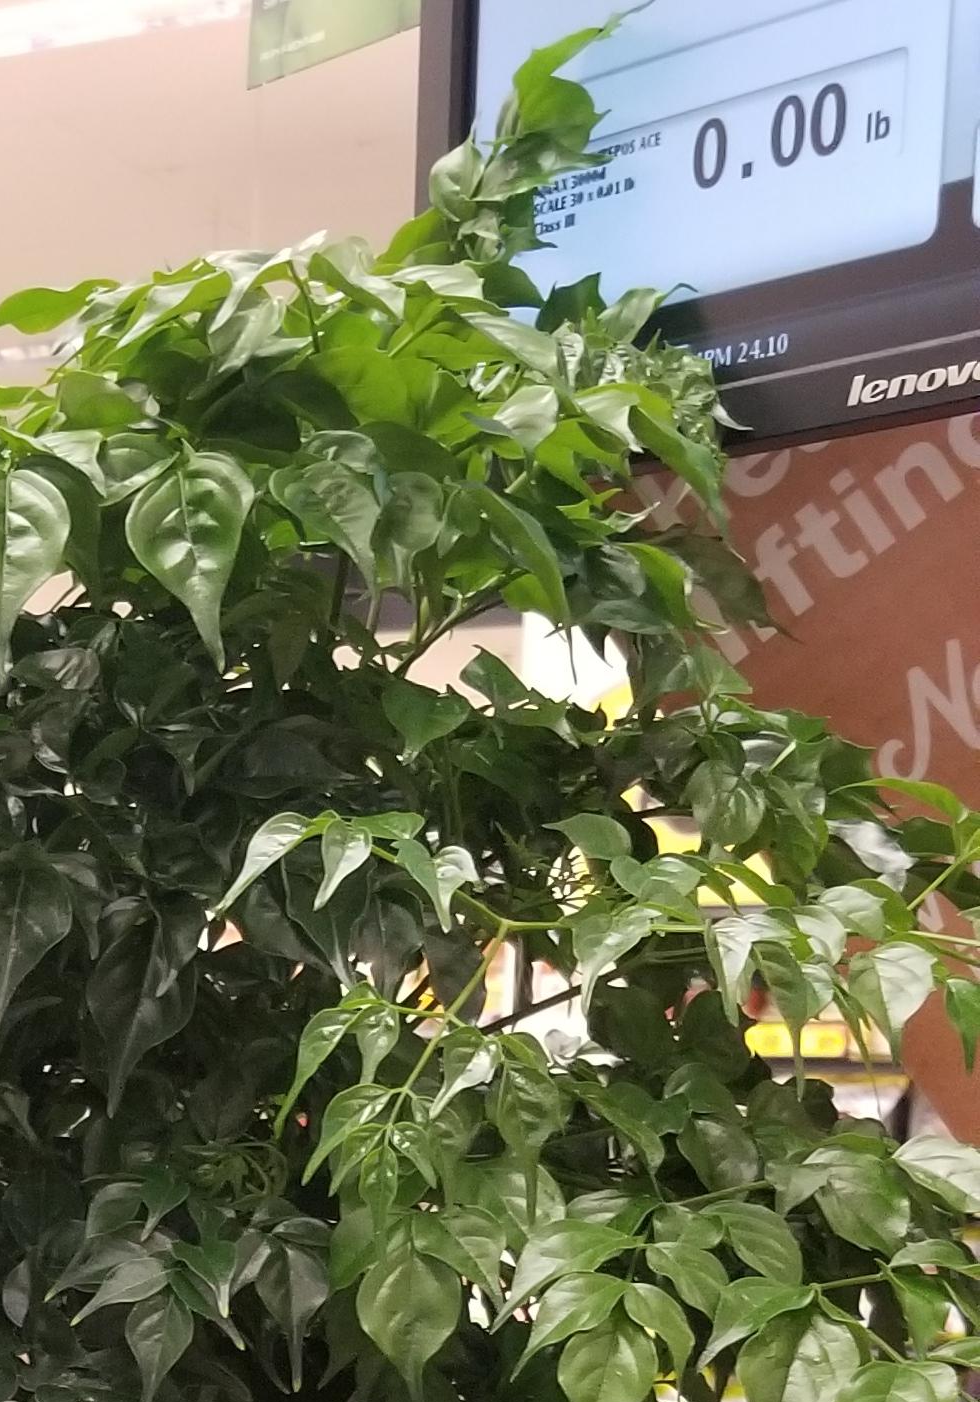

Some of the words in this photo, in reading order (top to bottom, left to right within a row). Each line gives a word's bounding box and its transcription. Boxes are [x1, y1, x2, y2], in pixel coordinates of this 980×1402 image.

[693, 83, 847, 189] 0.00
[866, 110, 891, 144] lb
[533, 195, 568, 216] SCALE
[737, 333, 789, 364] 24.10
[846, 360, 980, 407] lenov
